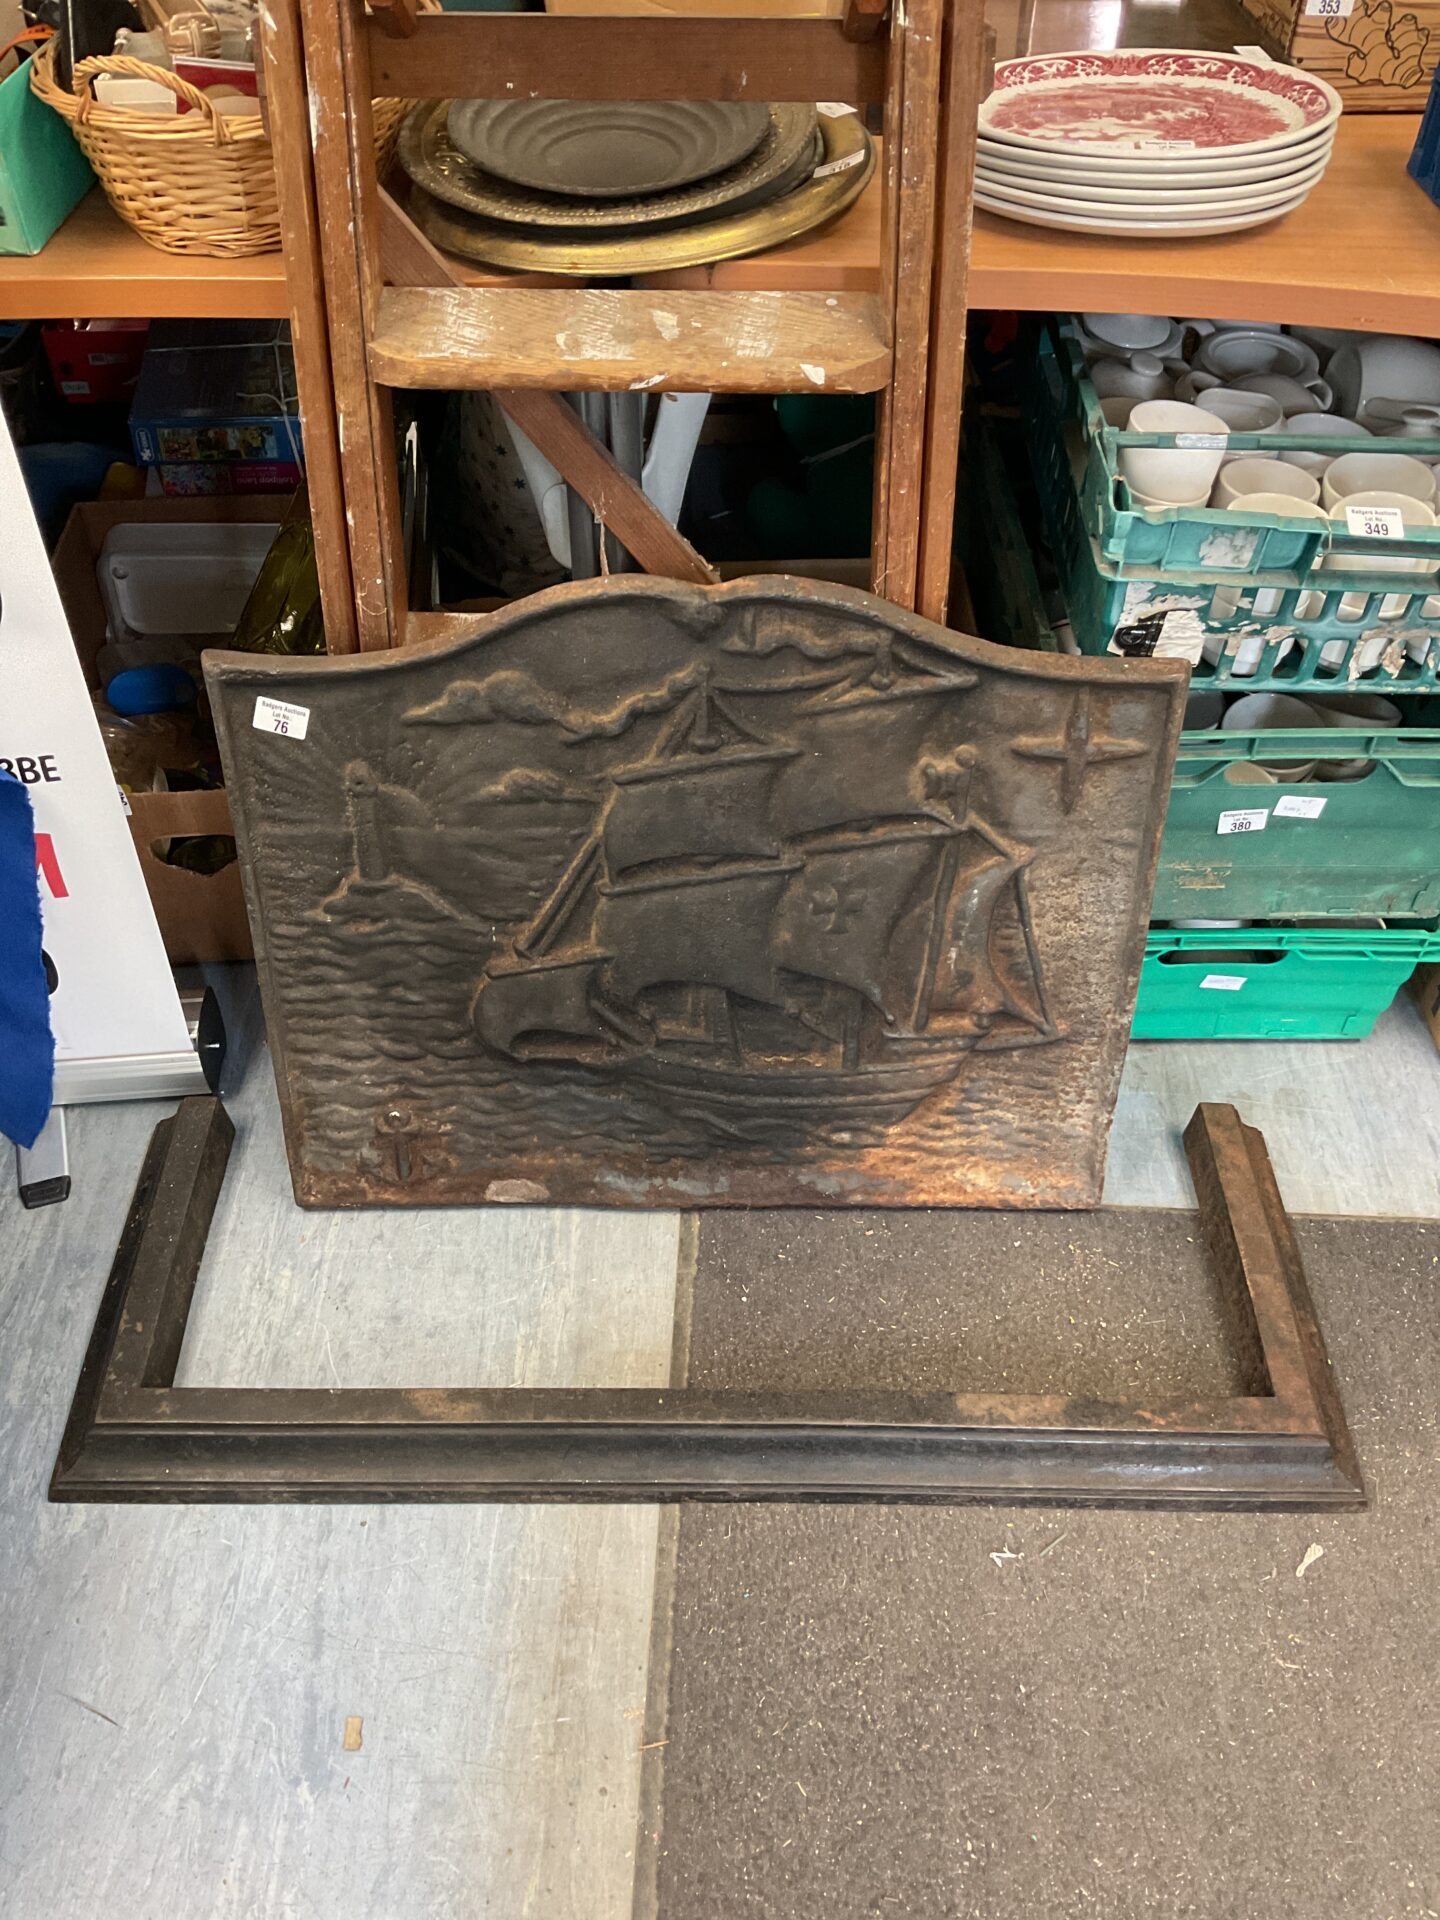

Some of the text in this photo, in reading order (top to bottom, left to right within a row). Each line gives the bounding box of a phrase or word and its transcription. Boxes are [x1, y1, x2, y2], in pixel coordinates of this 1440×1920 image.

[1319, 0, 1341, 14] 353
[1364, 522, 1389, 536] 349
[262, 700, 306, 717] Badgers Auctions
[273, 719, 289, 734] 76
[1230, 821, 1251, 832] 380
